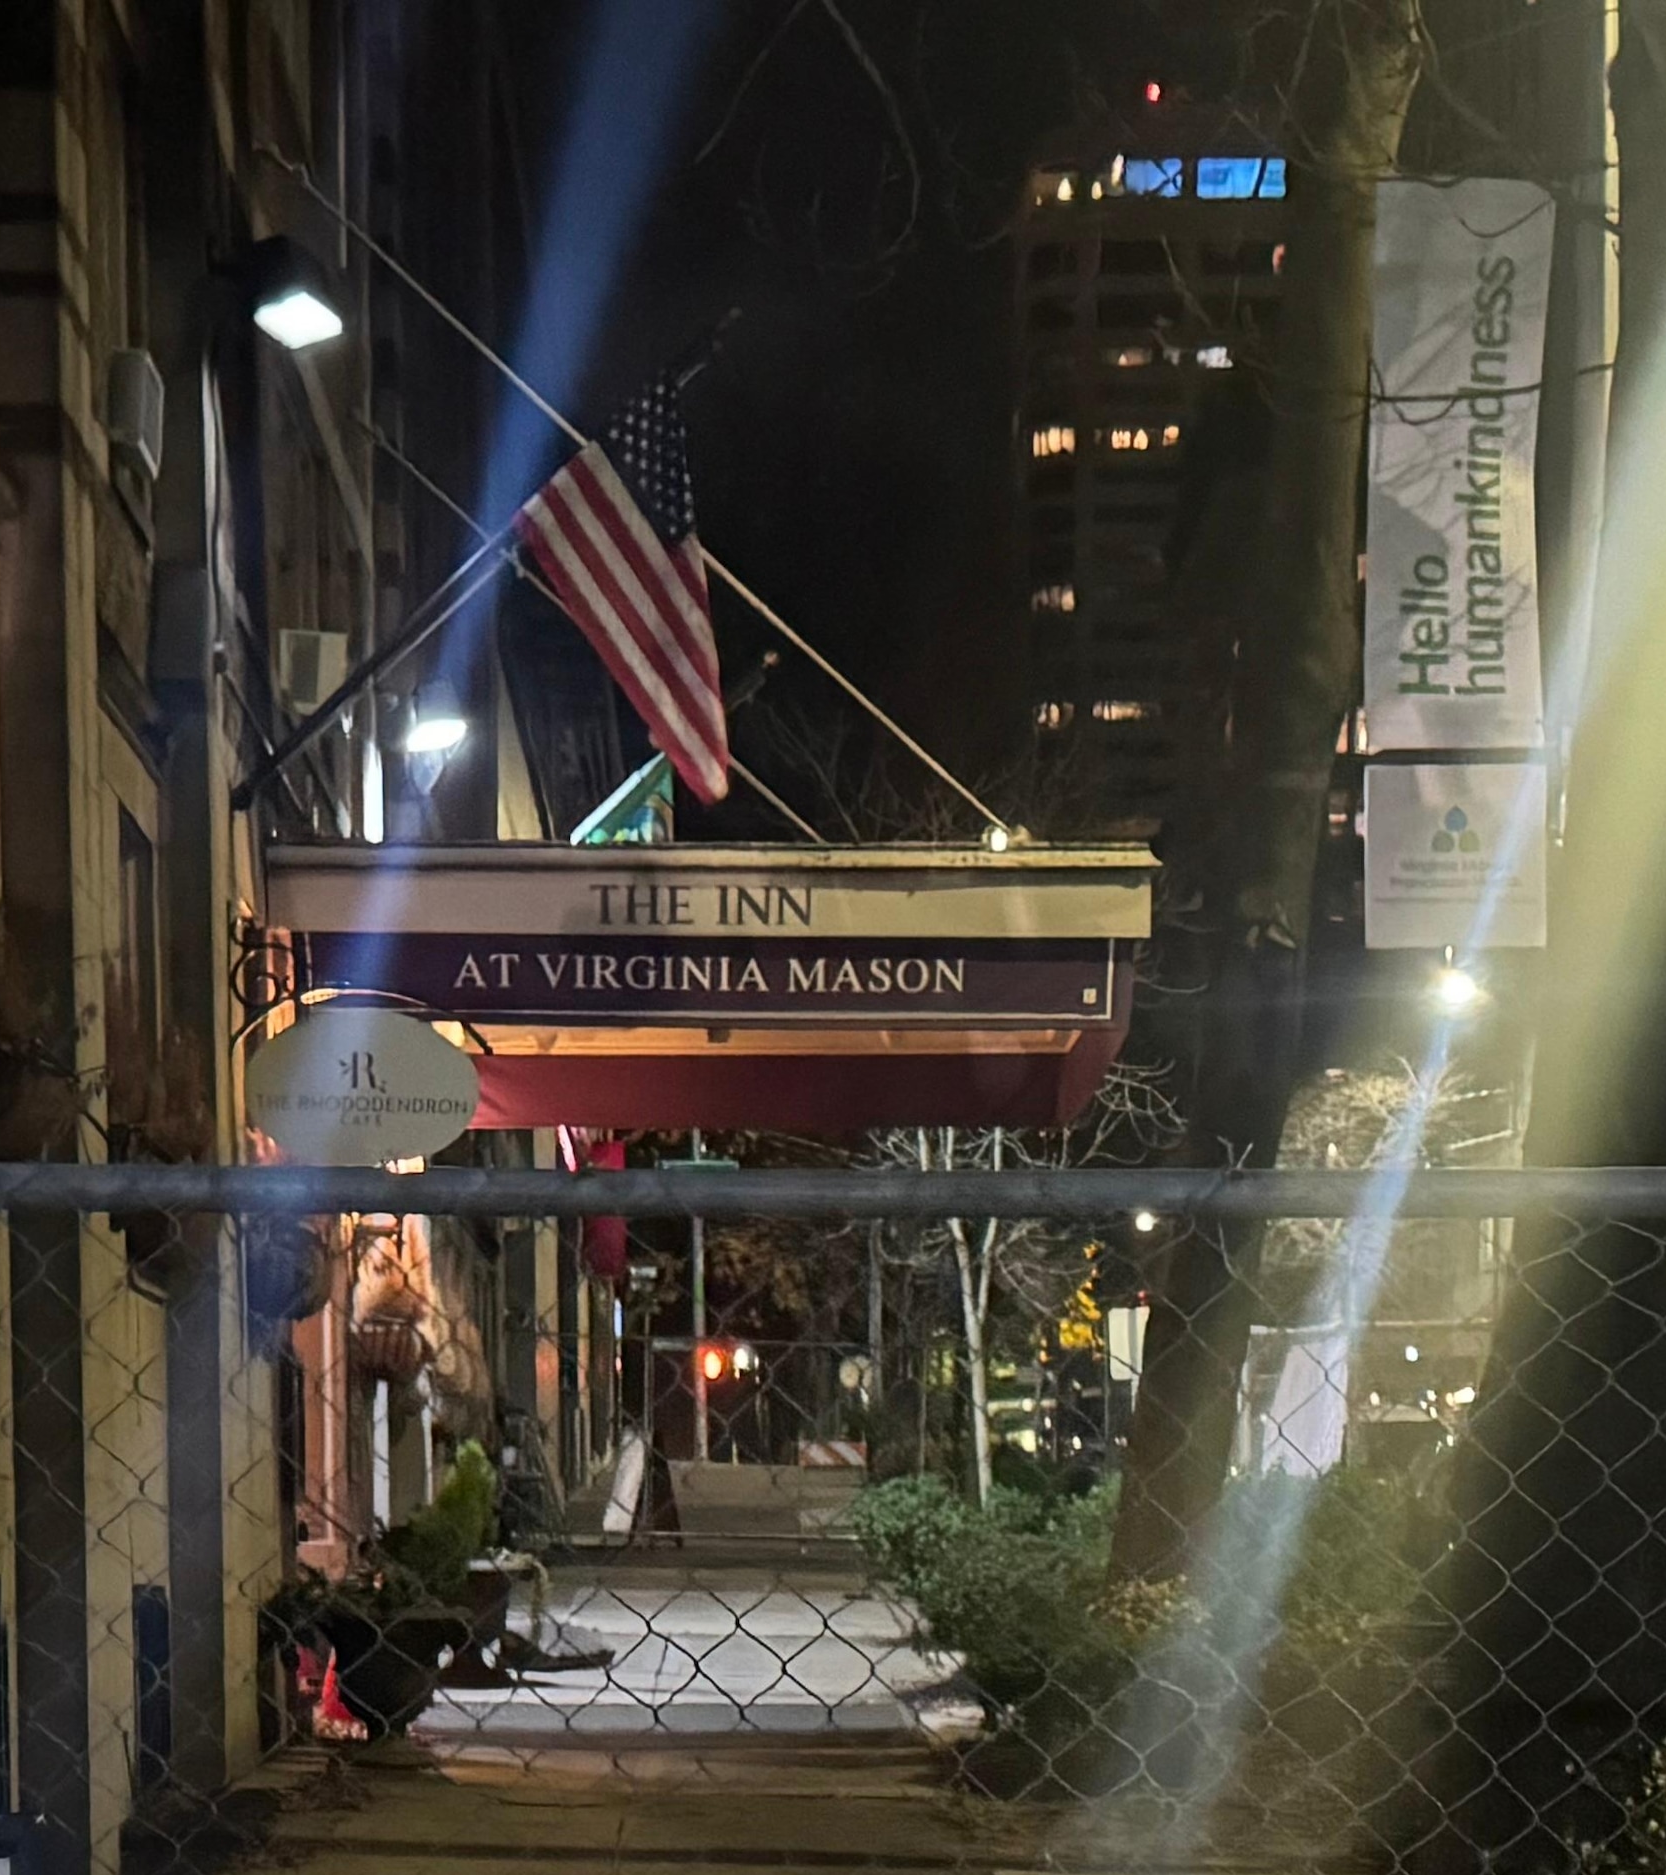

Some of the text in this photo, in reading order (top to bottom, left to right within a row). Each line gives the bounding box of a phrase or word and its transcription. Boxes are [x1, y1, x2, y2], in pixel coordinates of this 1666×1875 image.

[1453, 254, 1516, 697] humankindness
[1398, 553, 1450, 697] Hello
[589, 884, 814, 928] THE INN
[453, 952, 967, 994] AT VIRGINIA MASON
[298, 1095, 470, 1116] RHODODENDRON
